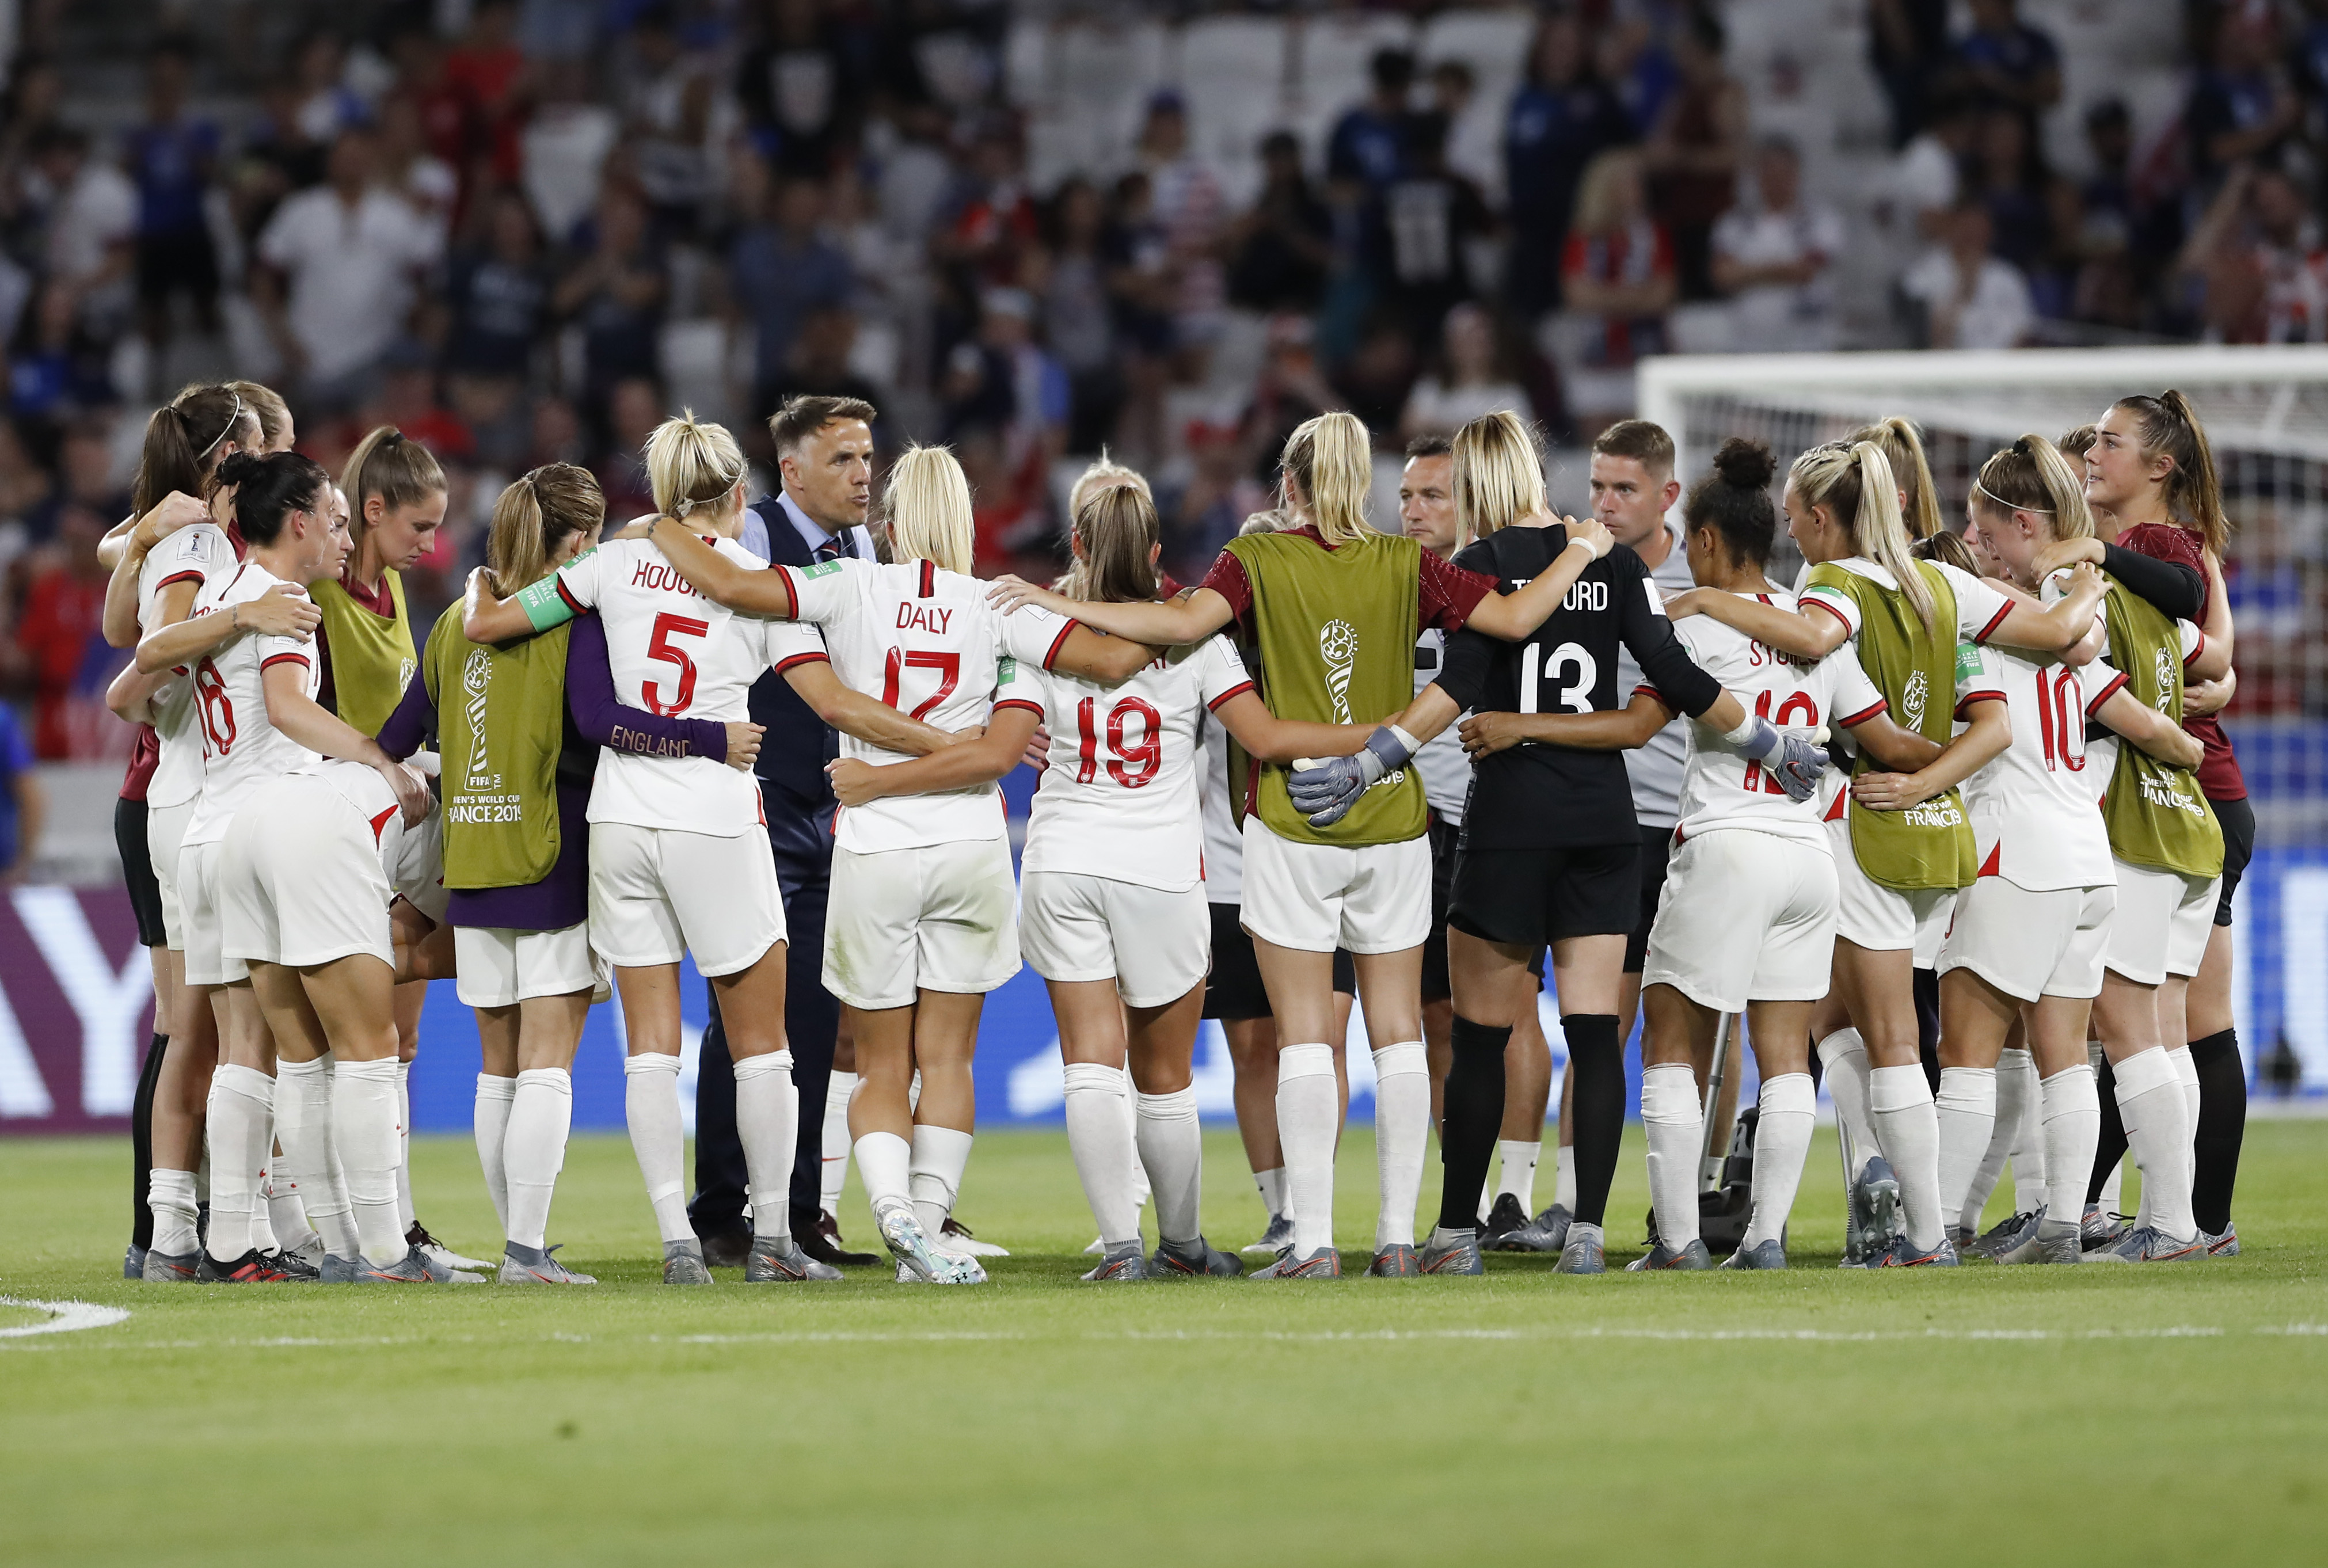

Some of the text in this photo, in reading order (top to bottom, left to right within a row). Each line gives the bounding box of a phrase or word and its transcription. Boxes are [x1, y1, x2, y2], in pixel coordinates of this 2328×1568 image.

[525, 589, 540, 608] FIFA
[896, 602, 953, 635] DALY
[641, 611, 709, 718] 5
[1520, 642, 1596, 714] 13
[882, 645, 960, 722] 17
[2036, 666, 2086, 772] 10
[610, 724, 691, 758] ENGLAND
[1077, 695, 1161, 788] 19
[470, 777, 489, 786] FIFA
[478, 796, 505, 804] WORLD
[507, 794, 520, 803] CUP
[494, 805, 522, 823] 2019
